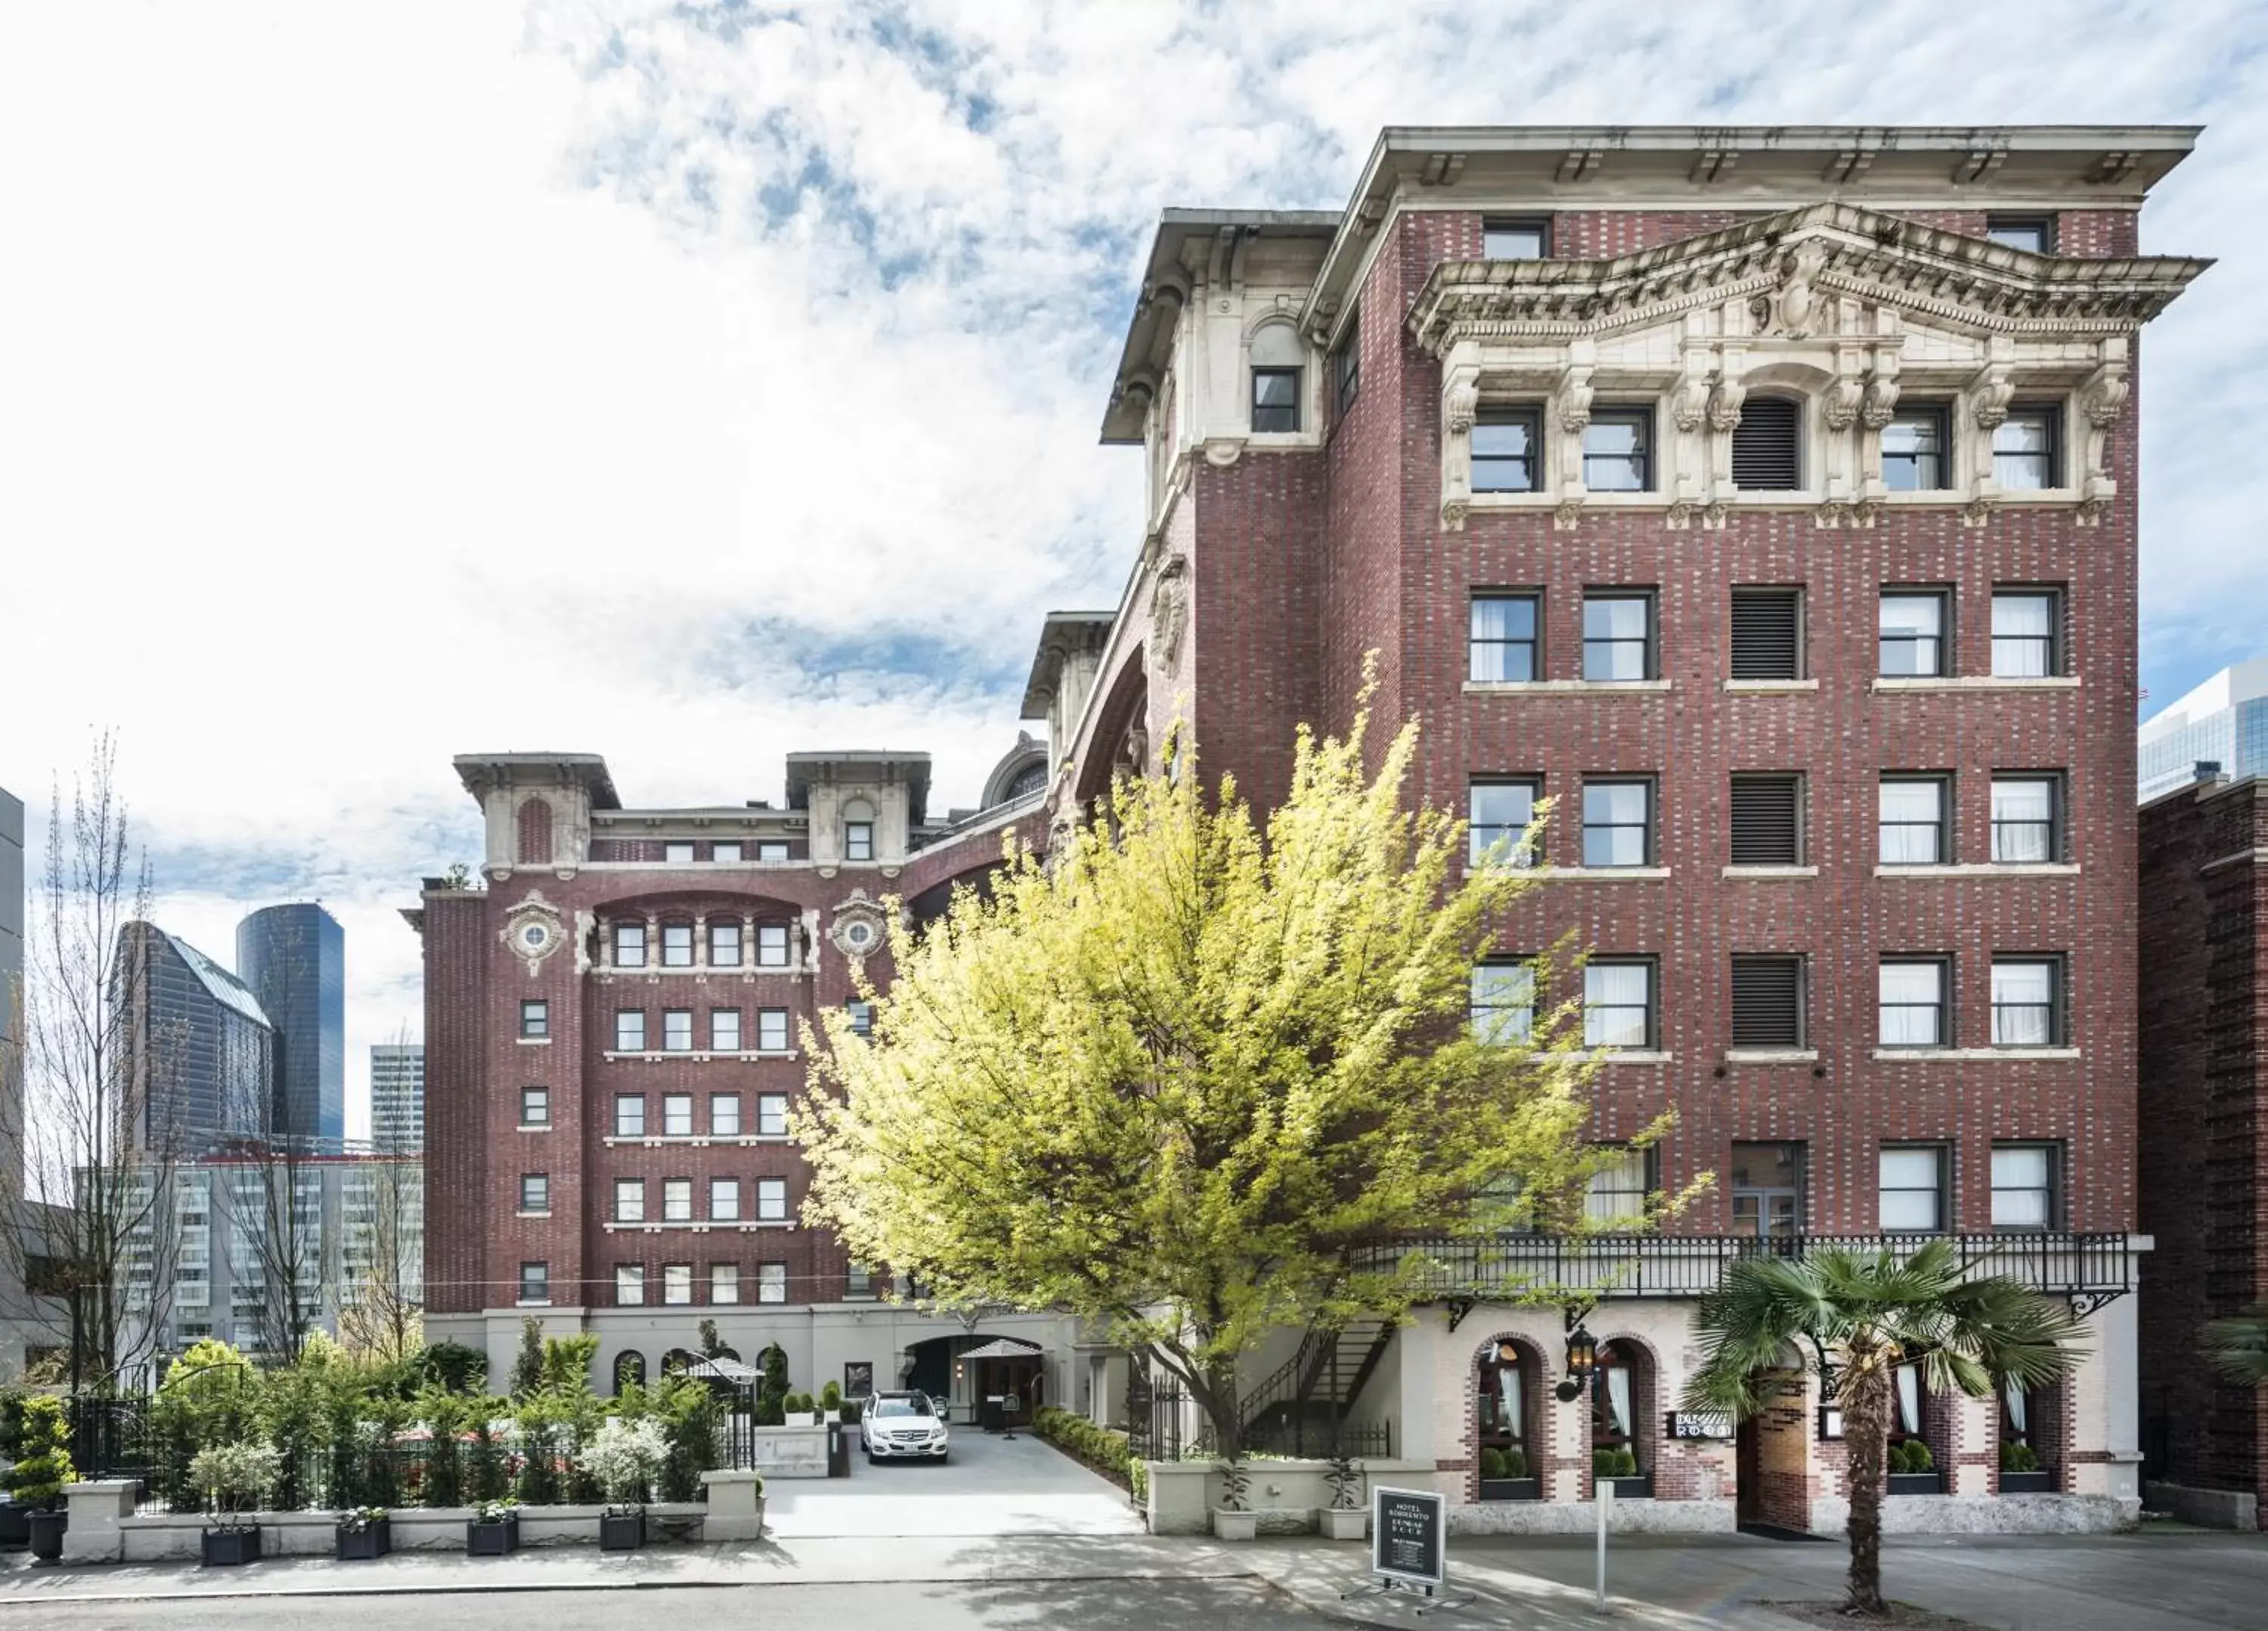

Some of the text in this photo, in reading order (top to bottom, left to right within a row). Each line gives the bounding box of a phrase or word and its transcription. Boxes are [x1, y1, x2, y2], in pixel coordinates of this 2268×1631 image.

[1676, 1425, 1731, 1437] ROOM
[1396, 1503, 1421, 1512] HOTEL
[1389, 1509, 1430, 1521] SORRENTO
